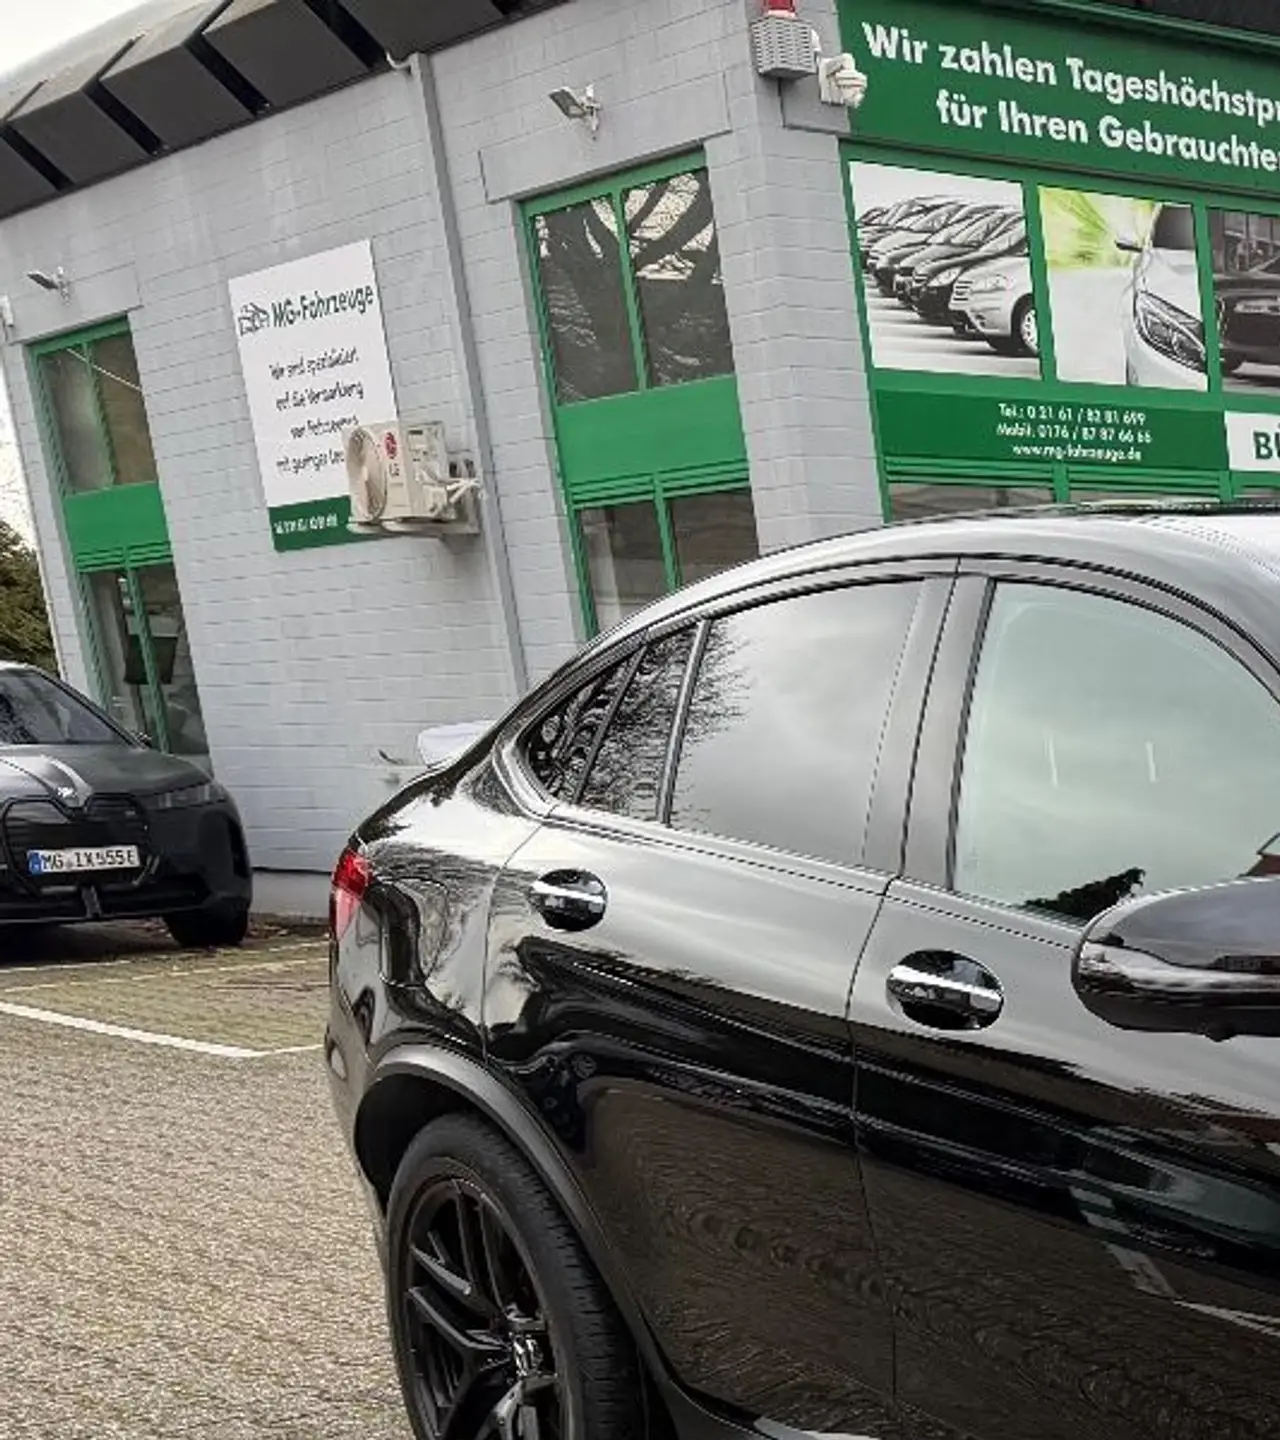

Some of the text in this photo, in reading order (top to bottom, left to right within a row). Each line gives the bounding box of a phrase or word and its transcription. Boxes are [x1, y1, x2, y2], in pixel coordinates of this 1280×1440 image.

[862, 21, 928, 64] Wir
[938, 41, 1057, 86] zahlen
[936, 89, 988, 130] für
[999, 100, 1088, 143] Ihren
